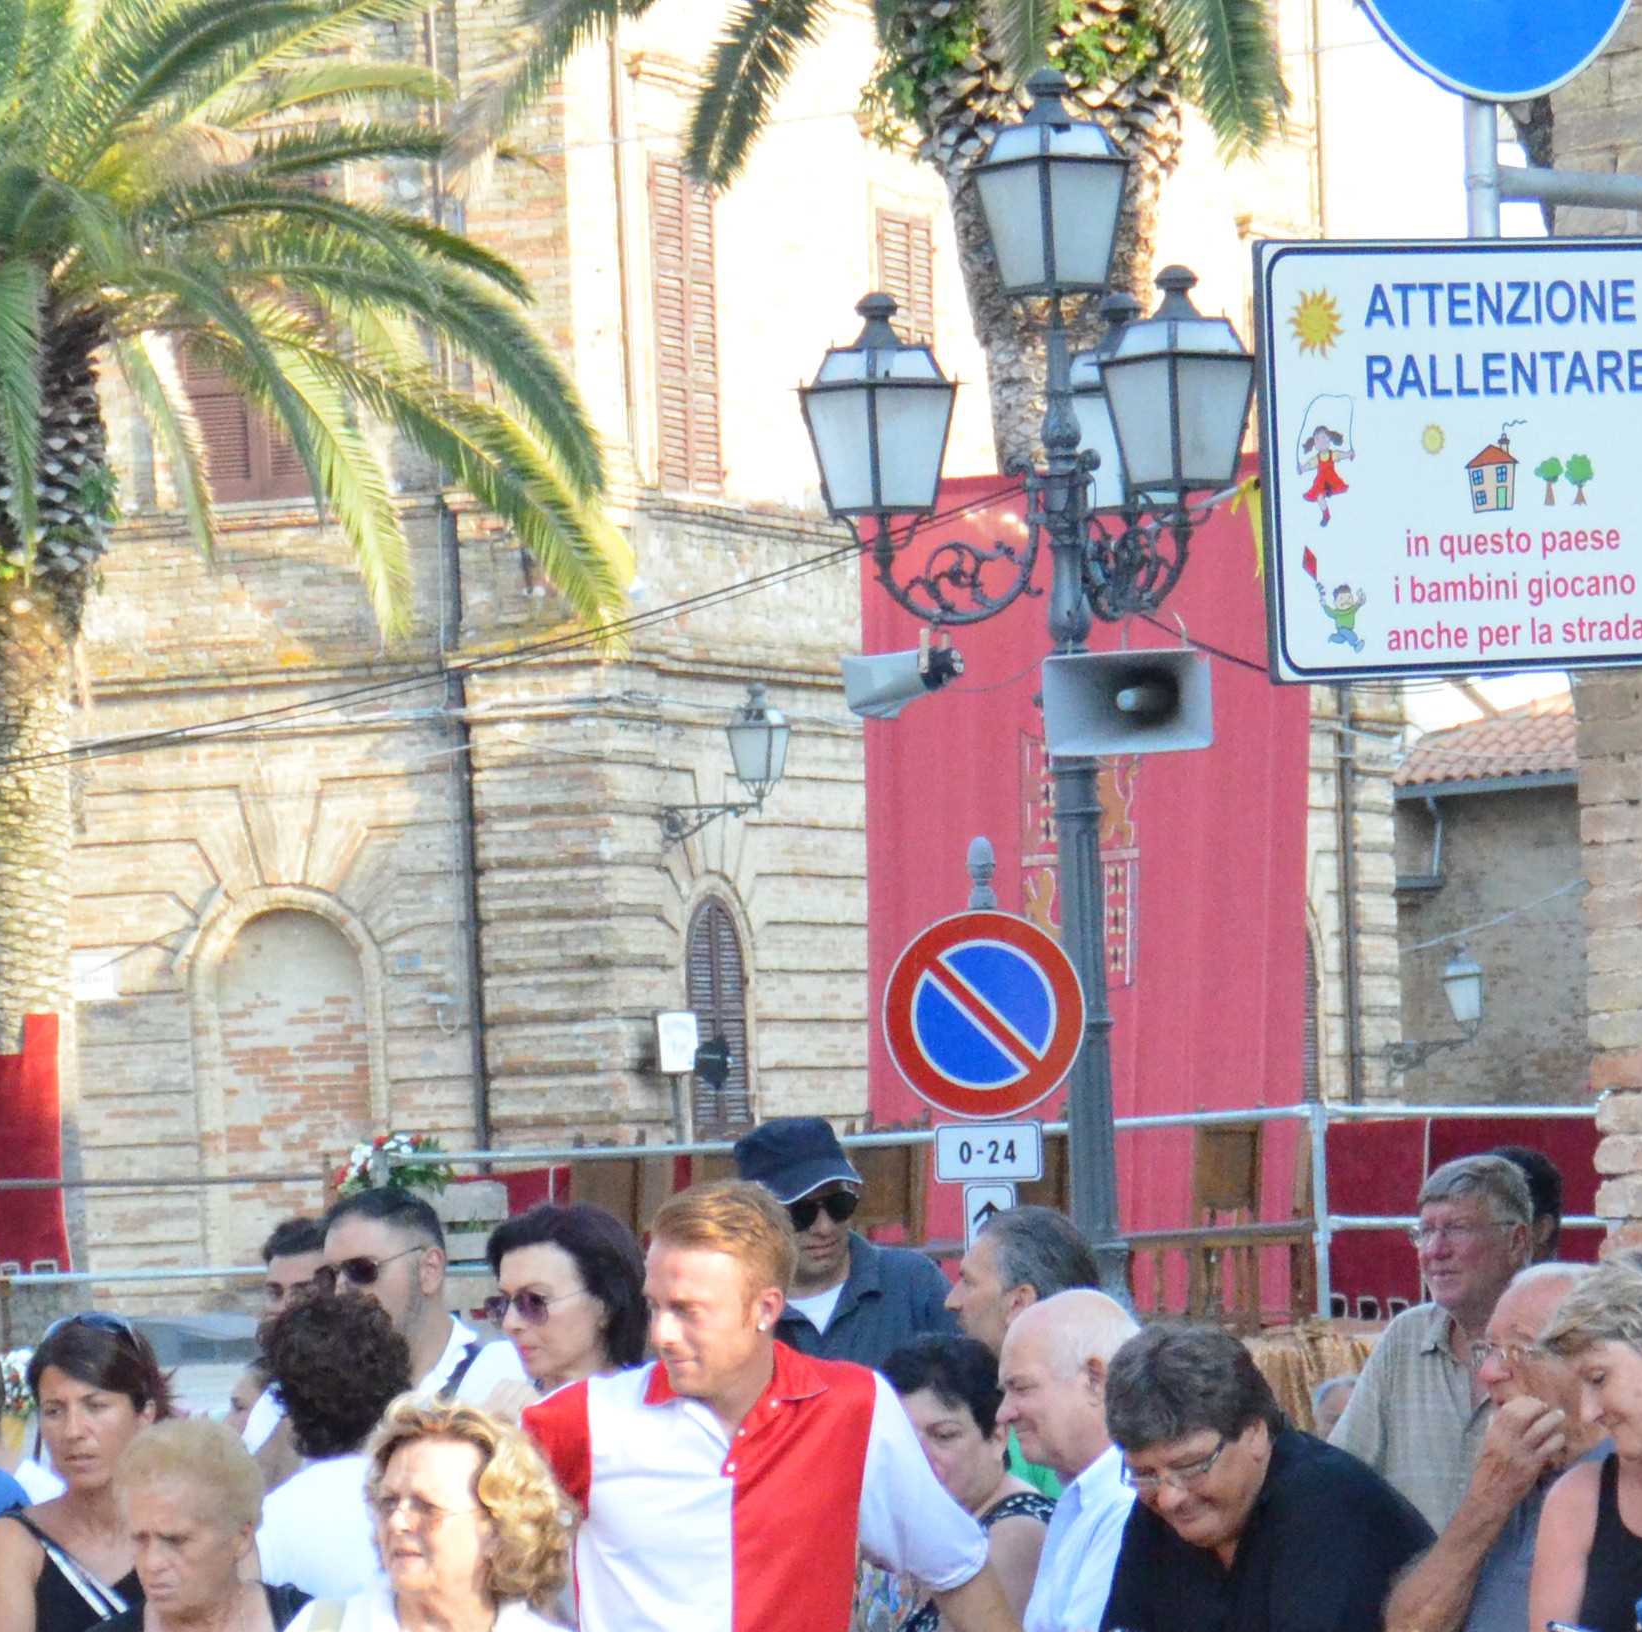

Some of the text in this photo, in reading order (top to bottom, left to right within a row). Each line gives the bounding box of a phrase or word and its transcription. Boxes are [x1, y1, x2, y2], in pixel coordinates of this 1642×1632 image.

[1365, 279, 1636, 327] ATTENZIONE
[1405, 527, 1621, 563] in questo paese
[1394, 570, 1636, 607] i bambini giocano
[1387, 620, 1468, 651] anche
[1478, 622, 1522, 654] per
[1530, 617, 1553, 645] la
[959, 1139, 1017, 1165] 0-24
